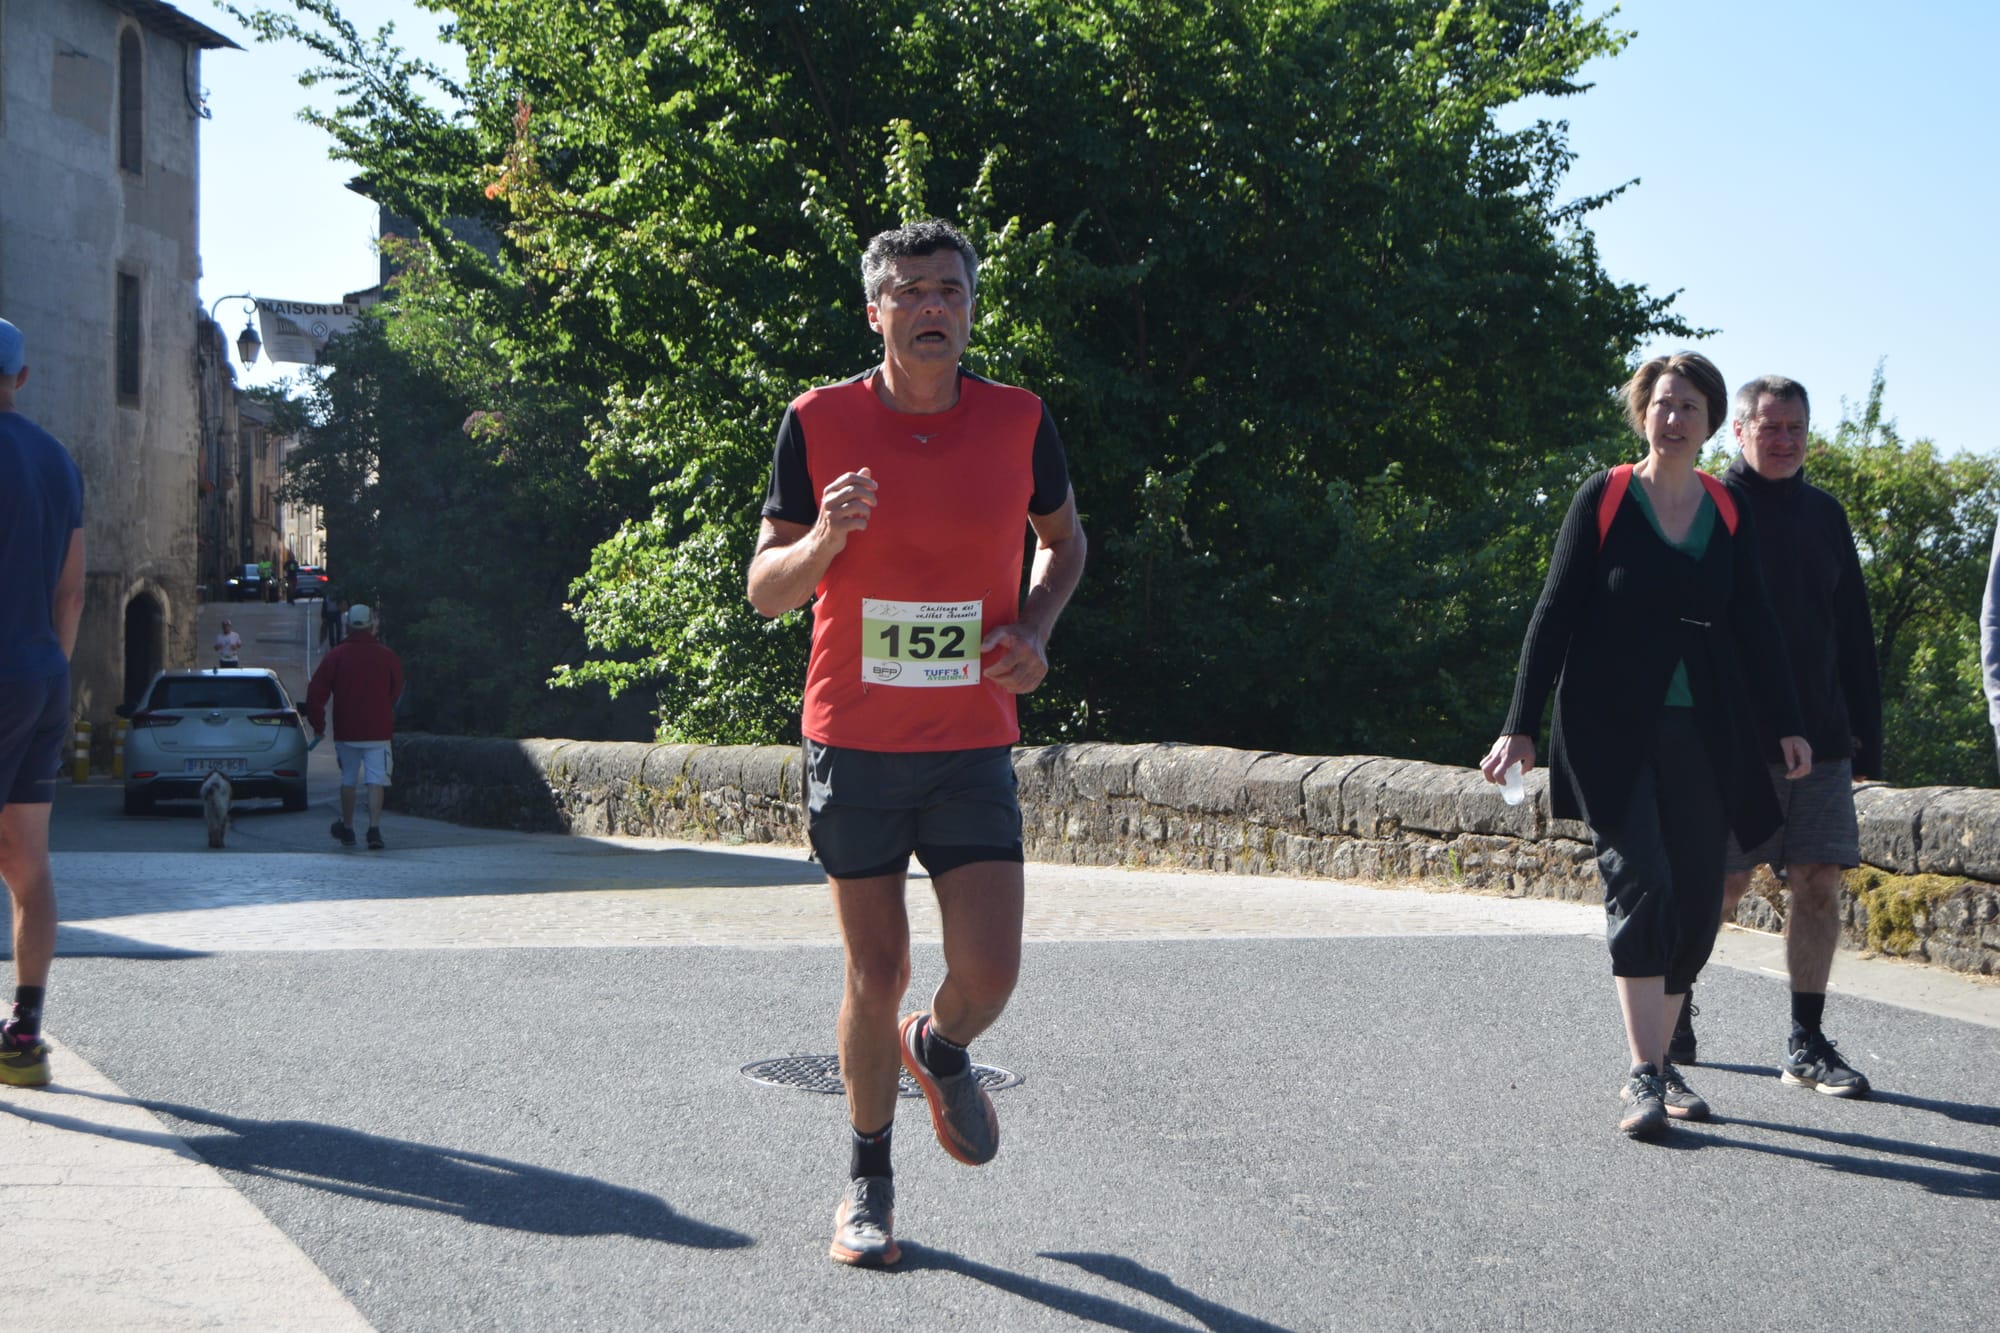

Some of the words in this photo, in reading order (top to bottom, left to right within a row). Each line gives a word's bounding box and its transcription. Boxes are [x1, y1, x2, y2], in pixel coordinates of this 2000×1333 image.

[261, 302, 327, 315] MAISON
[333, 305, 353, 316] DE
[920, 605, 958, 614] Challenge
[880, 625, 966, 659] 152
[924, 668, 959, 677] TUFF'S
